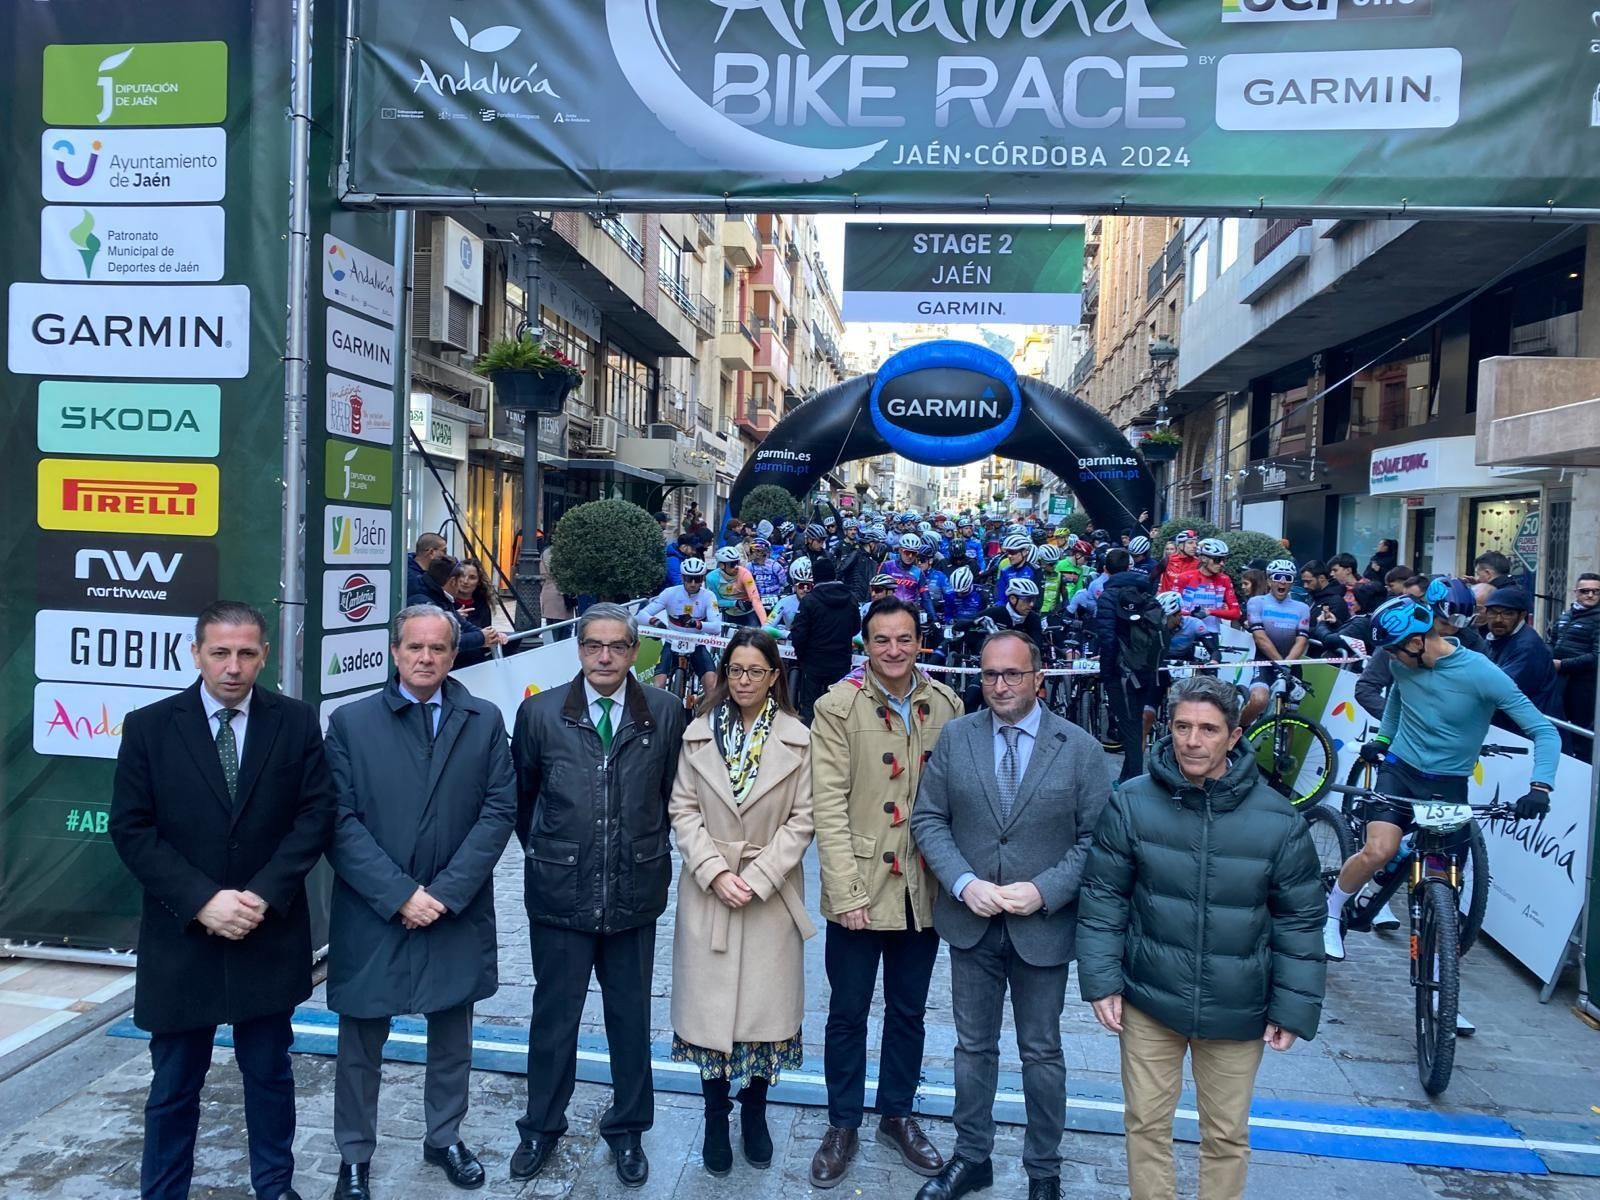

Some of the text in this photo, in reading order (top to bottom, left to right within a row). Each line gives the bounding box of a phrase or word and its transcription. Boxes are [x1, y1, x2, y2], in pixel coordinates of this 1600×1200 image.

[1199, 56, 1216, 65] BY
[412, 59, 560, 98] Andalucía
[115, 82, 178, 94] DIPUTACIÓN
[713, 52, 1189, 129] BIKE RACE
[1243, 75, 1433, 106] GARMIN
[115, 95, 158, 106] DE JAÉN
[109, 155, 217, 172] Ayuntamiento
[1121, 146, 1191, 168] 2024
[109, 173, 171, 188] de Jaén
[108, 230, 158, 241] Patronato
[913, 233, 1013, 255] STAGE 2
[108, 246, 174, 259] Municipal de
[108, 261, 199, 274] Deportes de Jaén
[931, 261, 992, 285] JAÉN
[917, 301, 1003, 316] GARMIN
[32, 313, 224, 348] GARMIN
[332, 329, 391, 366] GARMIN
[887, 398, 1000, 419] GARMIN
[757, 448, 812, 462] garmin.es
[1078, 454, 1138, 469] garmin.es
[754, 462, 809, 476] garmin.pt
[1079, 468, 1140, 482] garmin.pt
[62, 478, 198, 516] PIRELLI
[354, 518, 386, 546] Jaén
[87, 586, 167, 600] northwave
[71, 627, 183, 672] GOBIK
[342, 651, 383, 673] sadeco
